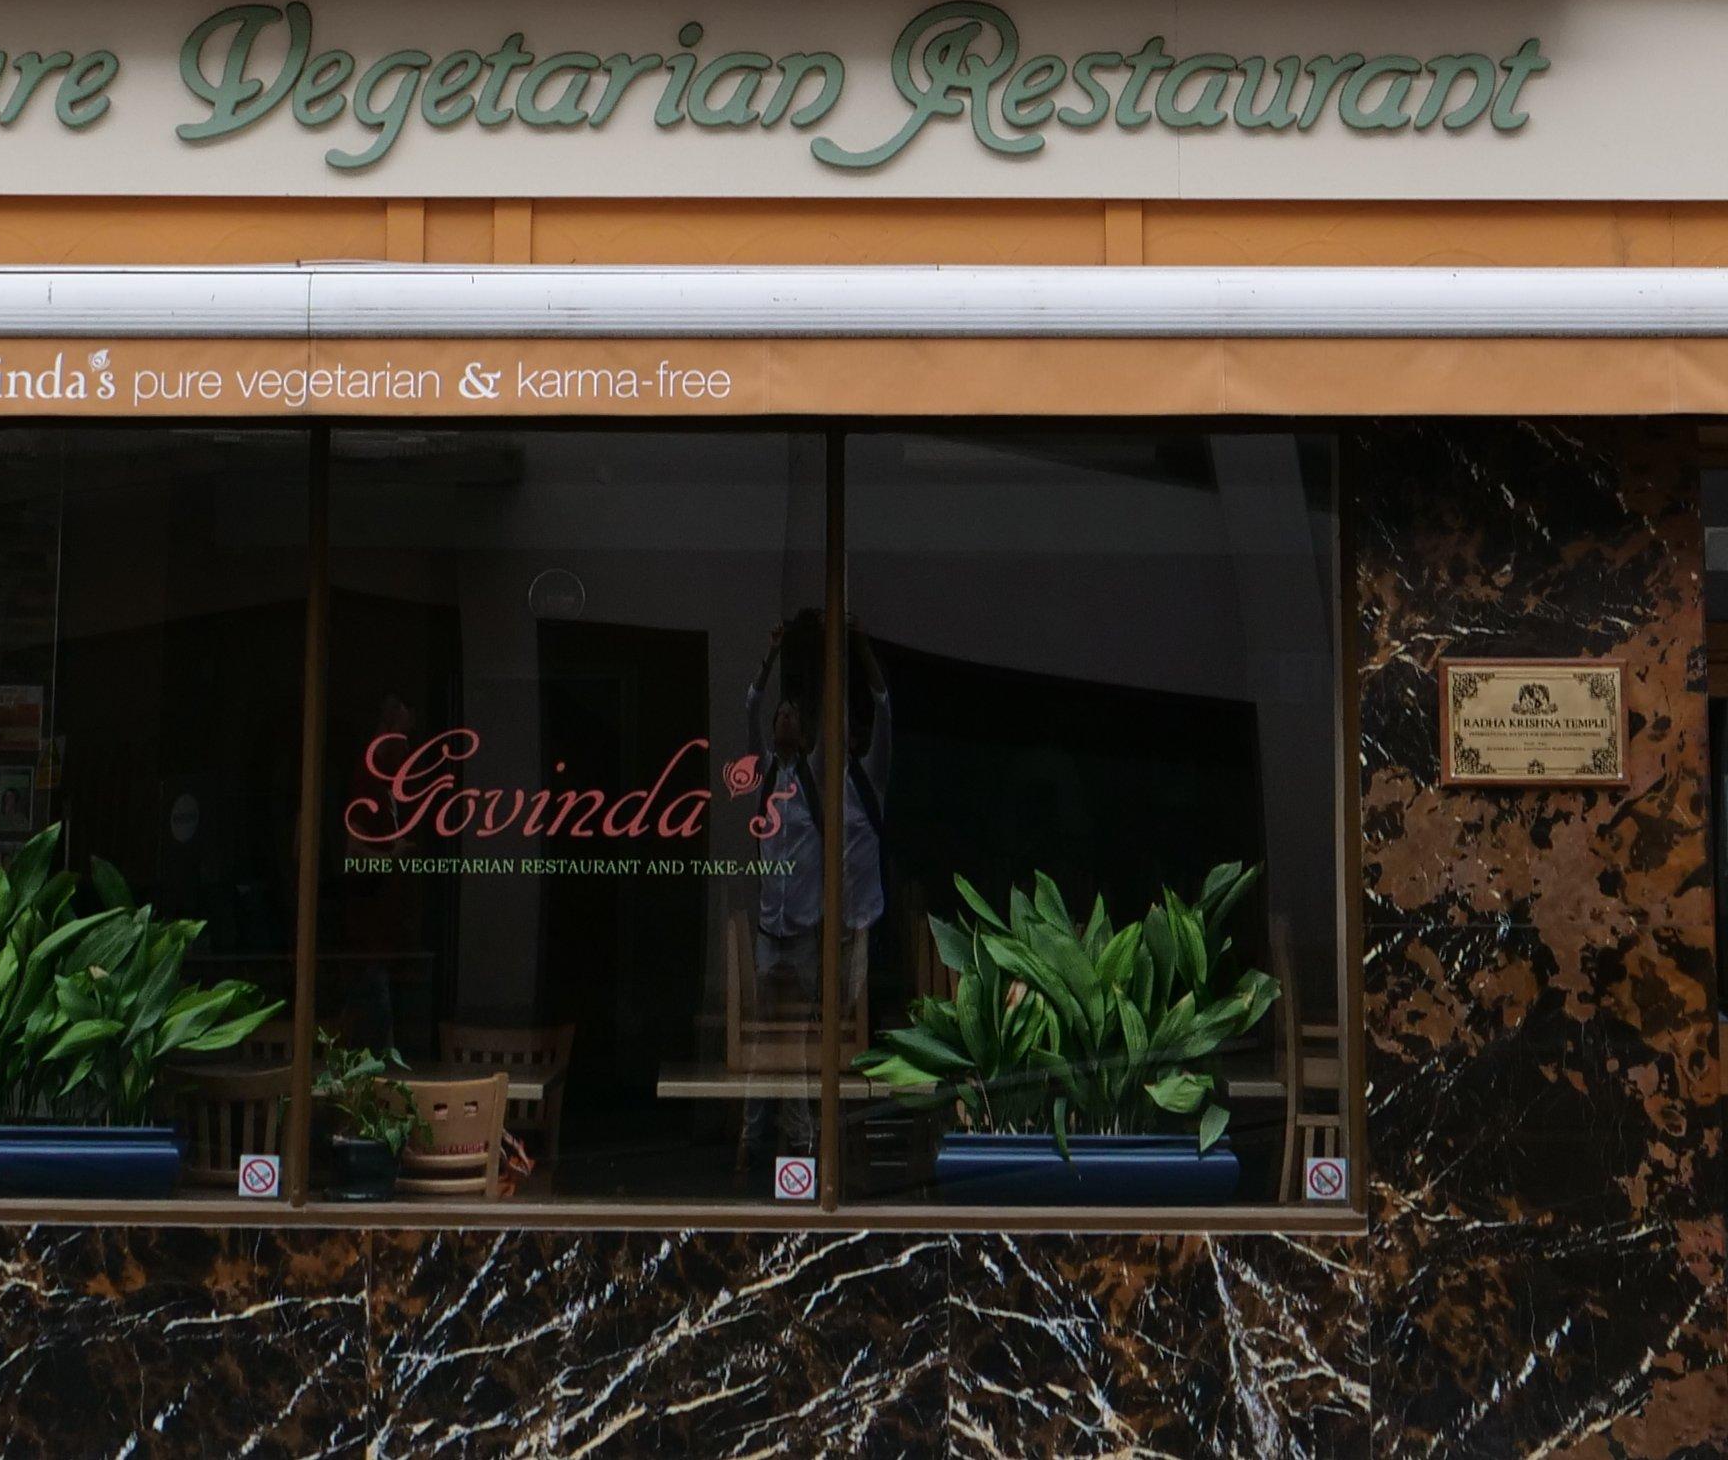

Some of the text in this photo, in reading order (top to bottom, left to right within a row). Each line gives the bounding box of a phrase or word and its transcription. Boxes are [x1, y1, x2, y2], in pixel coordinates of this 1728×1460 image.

[133, 369, 223, 407] pure
[235, 361, 441, 408] vegetarian
[458, 361, 503, 400] &
[517, 359, 732, 399] karma-free
[1463, 718, 1609, 730] RADHA KRISHNA TEMPLE
[344, 727, 798, 843] Govinda's
[343, 857, 798, 878] PURE VEGETARIAN RESTAURANT AND TAKE-AWAY
